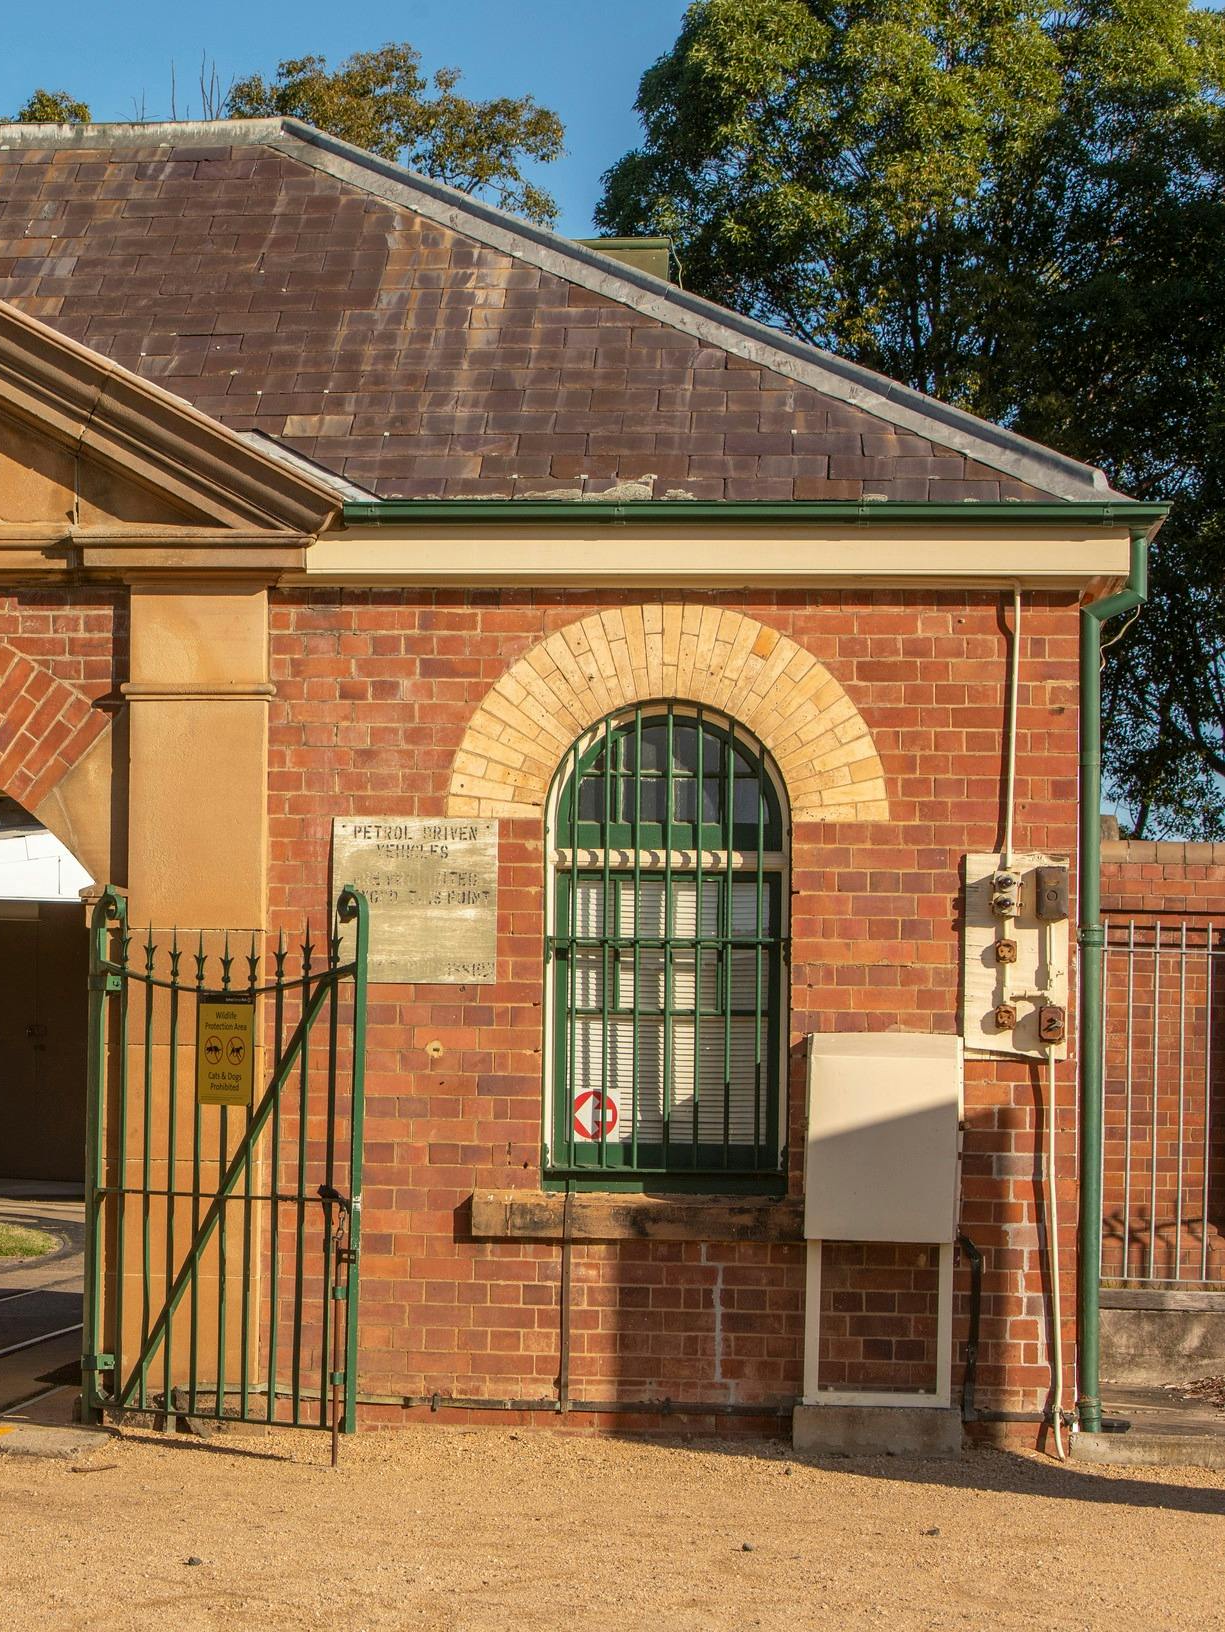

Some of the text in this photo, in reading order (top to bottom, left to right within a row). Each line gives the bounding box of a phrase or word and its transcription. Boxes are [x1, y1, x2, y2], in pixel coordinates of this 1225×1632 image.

[354, 825, 478, 841] PETROL DRIVEN
[376, 844, 449, 860] VEHICLES
[215, 1010, 238, 1020] Wildlife
[204, 1022, 248, 1031] Protection Area
[208, 1071, 220, 1080] Cats
[227, 1072, 242, 1082] Dogs
[210, 1082, 240, 1091] Prohibited
